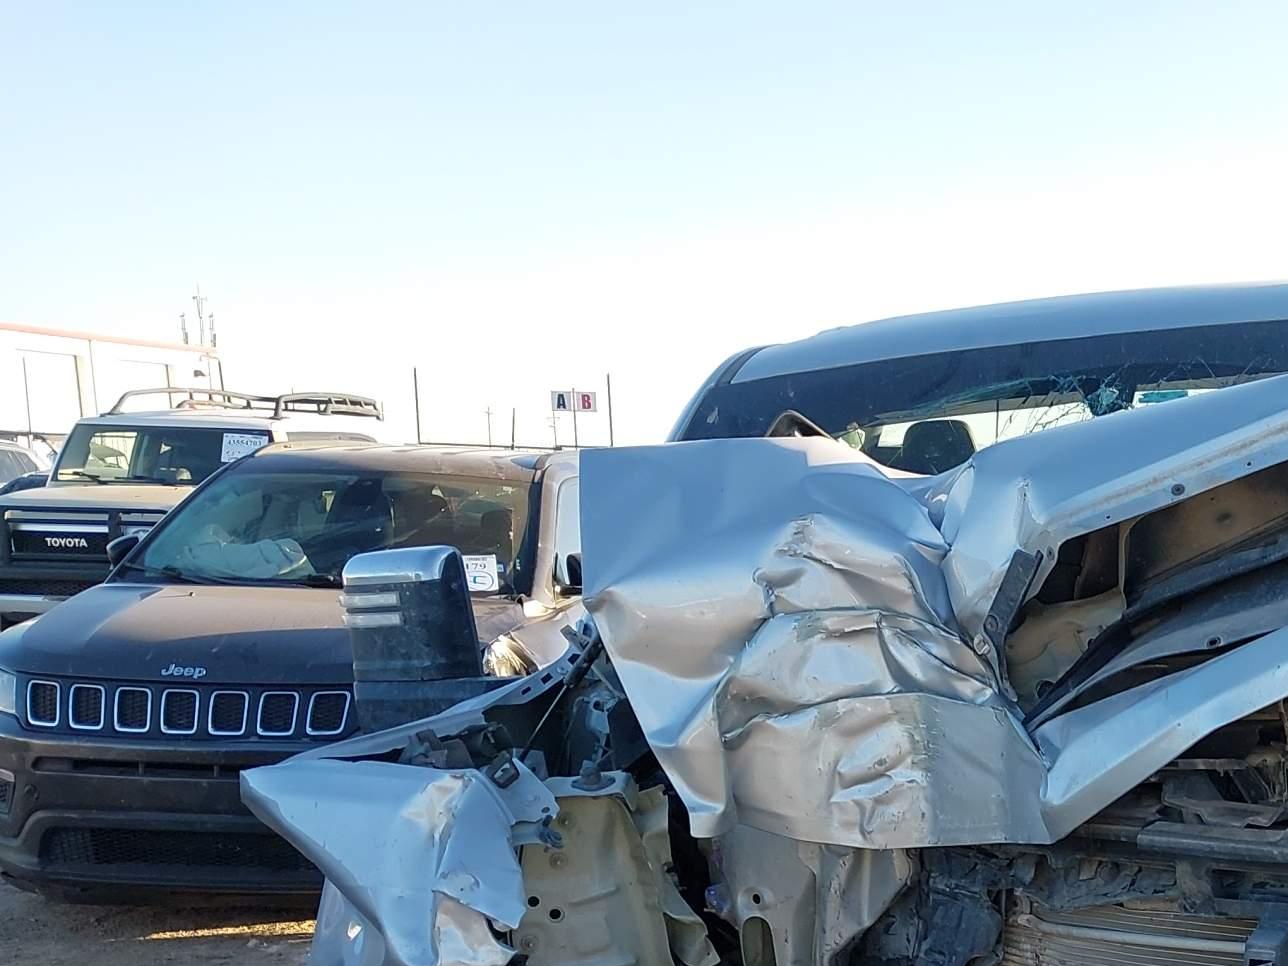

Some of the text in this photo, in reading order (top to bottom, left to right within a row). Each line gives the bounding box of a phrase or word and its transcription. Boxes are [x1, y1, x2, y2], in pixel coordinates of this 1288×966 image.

[556, 393, 567, 409] A
[581, 394, 592, 410] B
[44, 537, 88, 548] TOYOTA
[160, 663, 207, 679] Jeep
